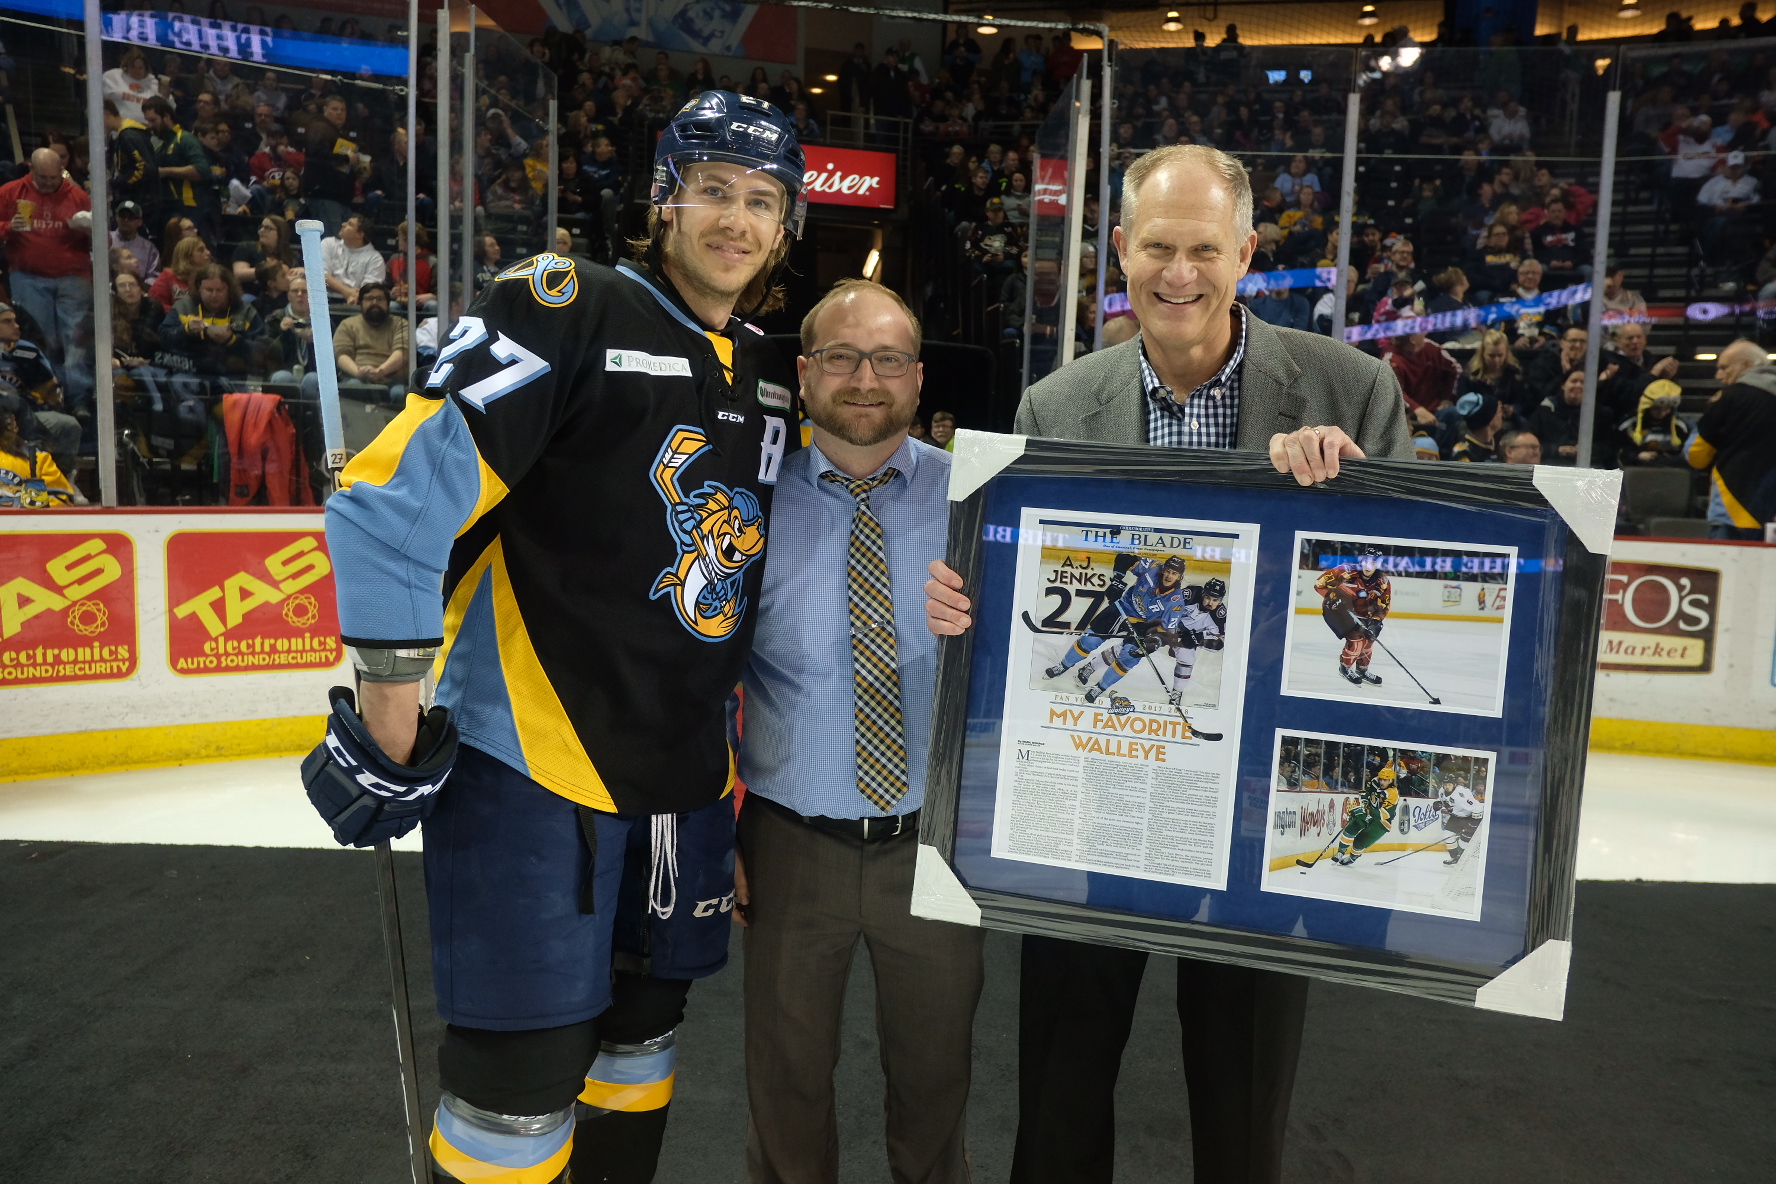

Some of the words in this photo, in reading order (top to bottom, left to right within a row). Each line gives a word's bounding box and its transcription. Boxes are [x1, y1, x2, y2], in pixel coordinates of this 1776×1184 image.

[730, 121, 779, 141] CCM
[803, 163, 880, 195] eiser
[425, 316, 551, 414] 27
[717, 410, 745, 424] CCM
[331, 453, 344, 465] 27
[1081, 529, 1121, 545] THE
[1129, 532, 1194, 550] BLADE
[1061, 555, 1094, 571] A.J.
[0, 537, 122, 642] AS
[173, 536, 331, 638] TAS
[1046, 569, 1107, 588] JENKS
[1041, 586, 1107, 631] 27
[1, 641, 130, 666] ectronics
[203, 632, 337, 655] electronics
[1603, 639, 1689, 659] Market
[177, 655, 217, 670] AUTO
[221, 651, 337, 668] SOUND/SECURITY
[1049, 707, 1085, 727] MY
[1092, 711, 1193, 740] FAVORITE
[1069, 733, 1167, 763] WALLEYE
[326, 728, 453, 801] CCM
